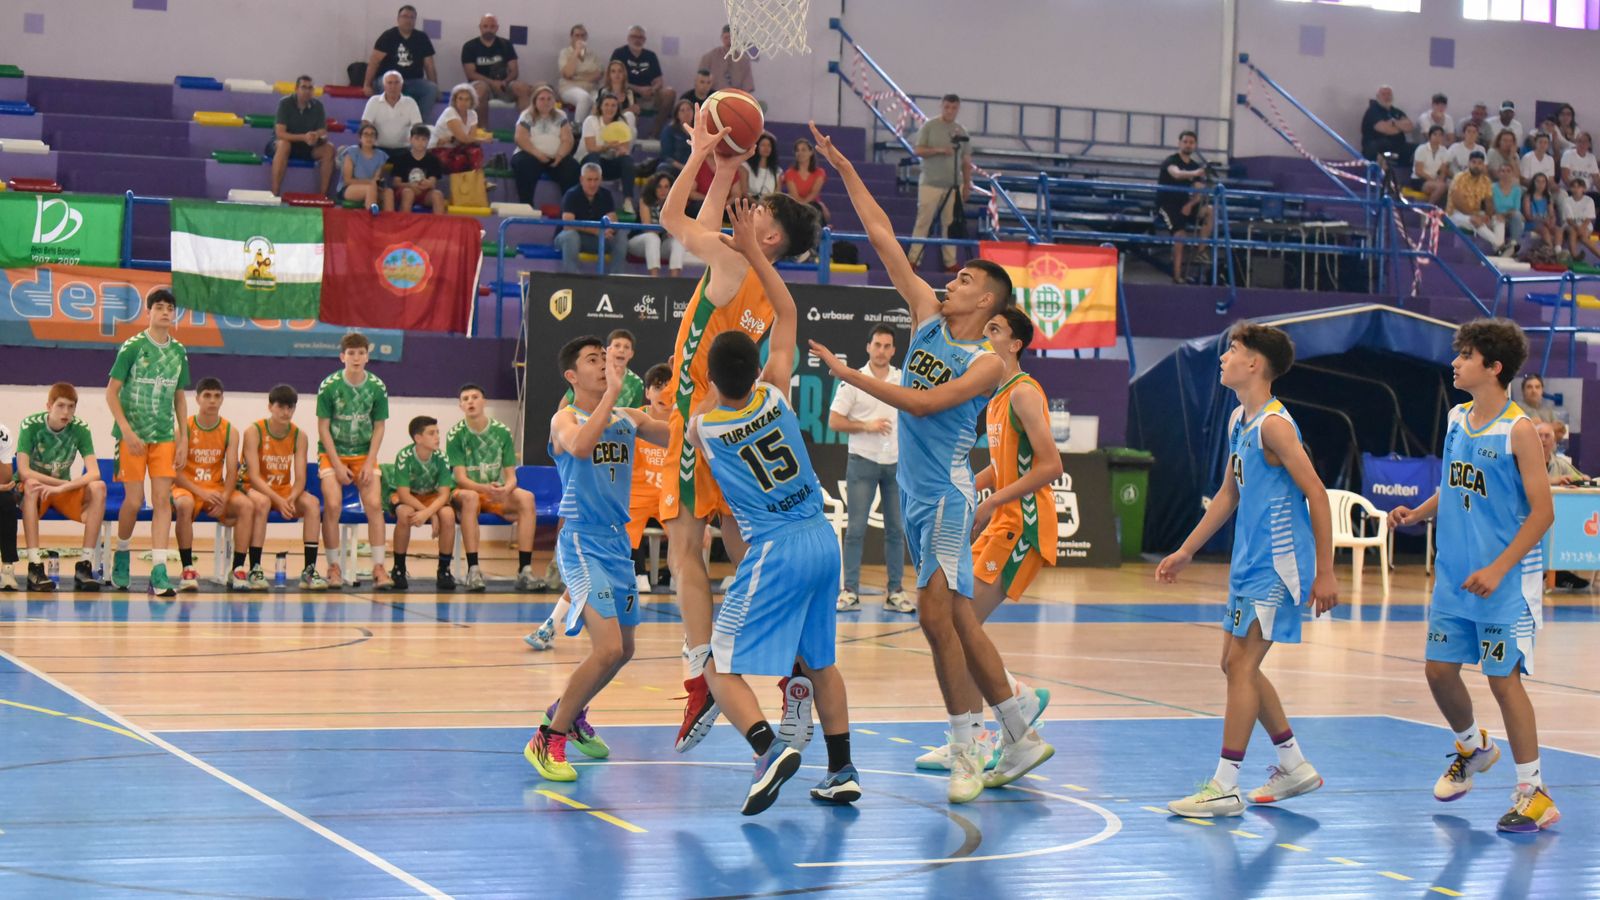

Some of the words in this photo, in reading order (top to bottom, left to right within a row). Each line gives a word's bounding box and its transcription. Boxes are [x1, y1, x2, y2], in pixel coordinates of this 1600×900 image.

[822, 310, 855, 320] urbaser
[864, 313, 882, 322] azul
[883, 314, 912, 323] marino
[907, 348, 953, 387] CBCA
[719, 406, 782, 447] TURANZAS
[592, 441, 630, 466] CBCA
[737, 426, 800, 493] 15
[194, 467, 212, 482] 36
[645, 469, 663, 489] 75
[1448, 460, 1488, 499] CBCA
[1372, 483, 1419, 497] molten
[625, 595, 634, 613] 7
[1427, 632, 1448, 643] BCA
[1484, 626, 1503, 635] vive
[1481, 640, 1505, 662] 74
